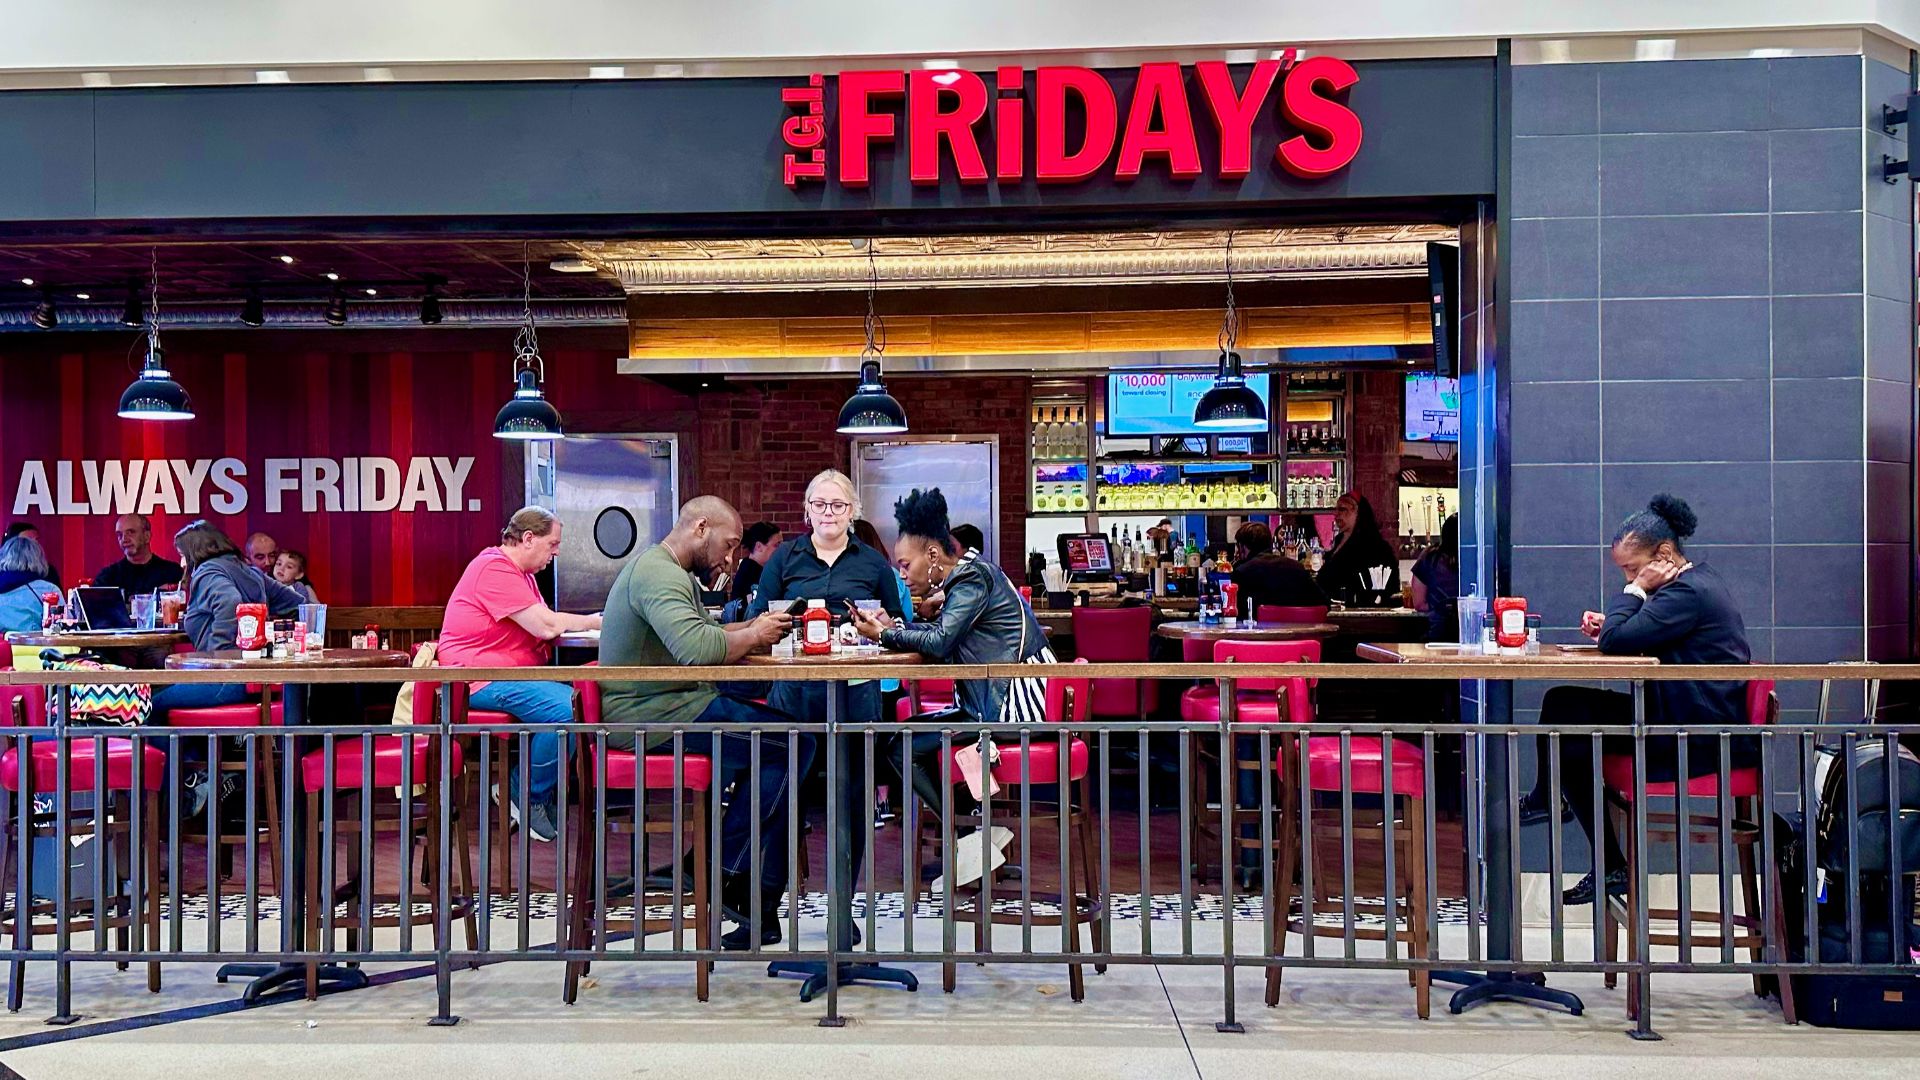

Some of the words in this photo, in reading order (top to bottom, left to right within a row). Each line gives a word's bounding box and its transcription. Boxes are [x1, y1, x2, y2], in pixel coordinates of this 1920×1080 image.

[781, 72, 826, 190] T.G.I.
[1119, 374, 1167, 389] $10,000
[1145, 389, 1167, 397] closing
[12, 457, 248, 516] ALWAYS
[265, 456, 481, 513] FRIDAY.
